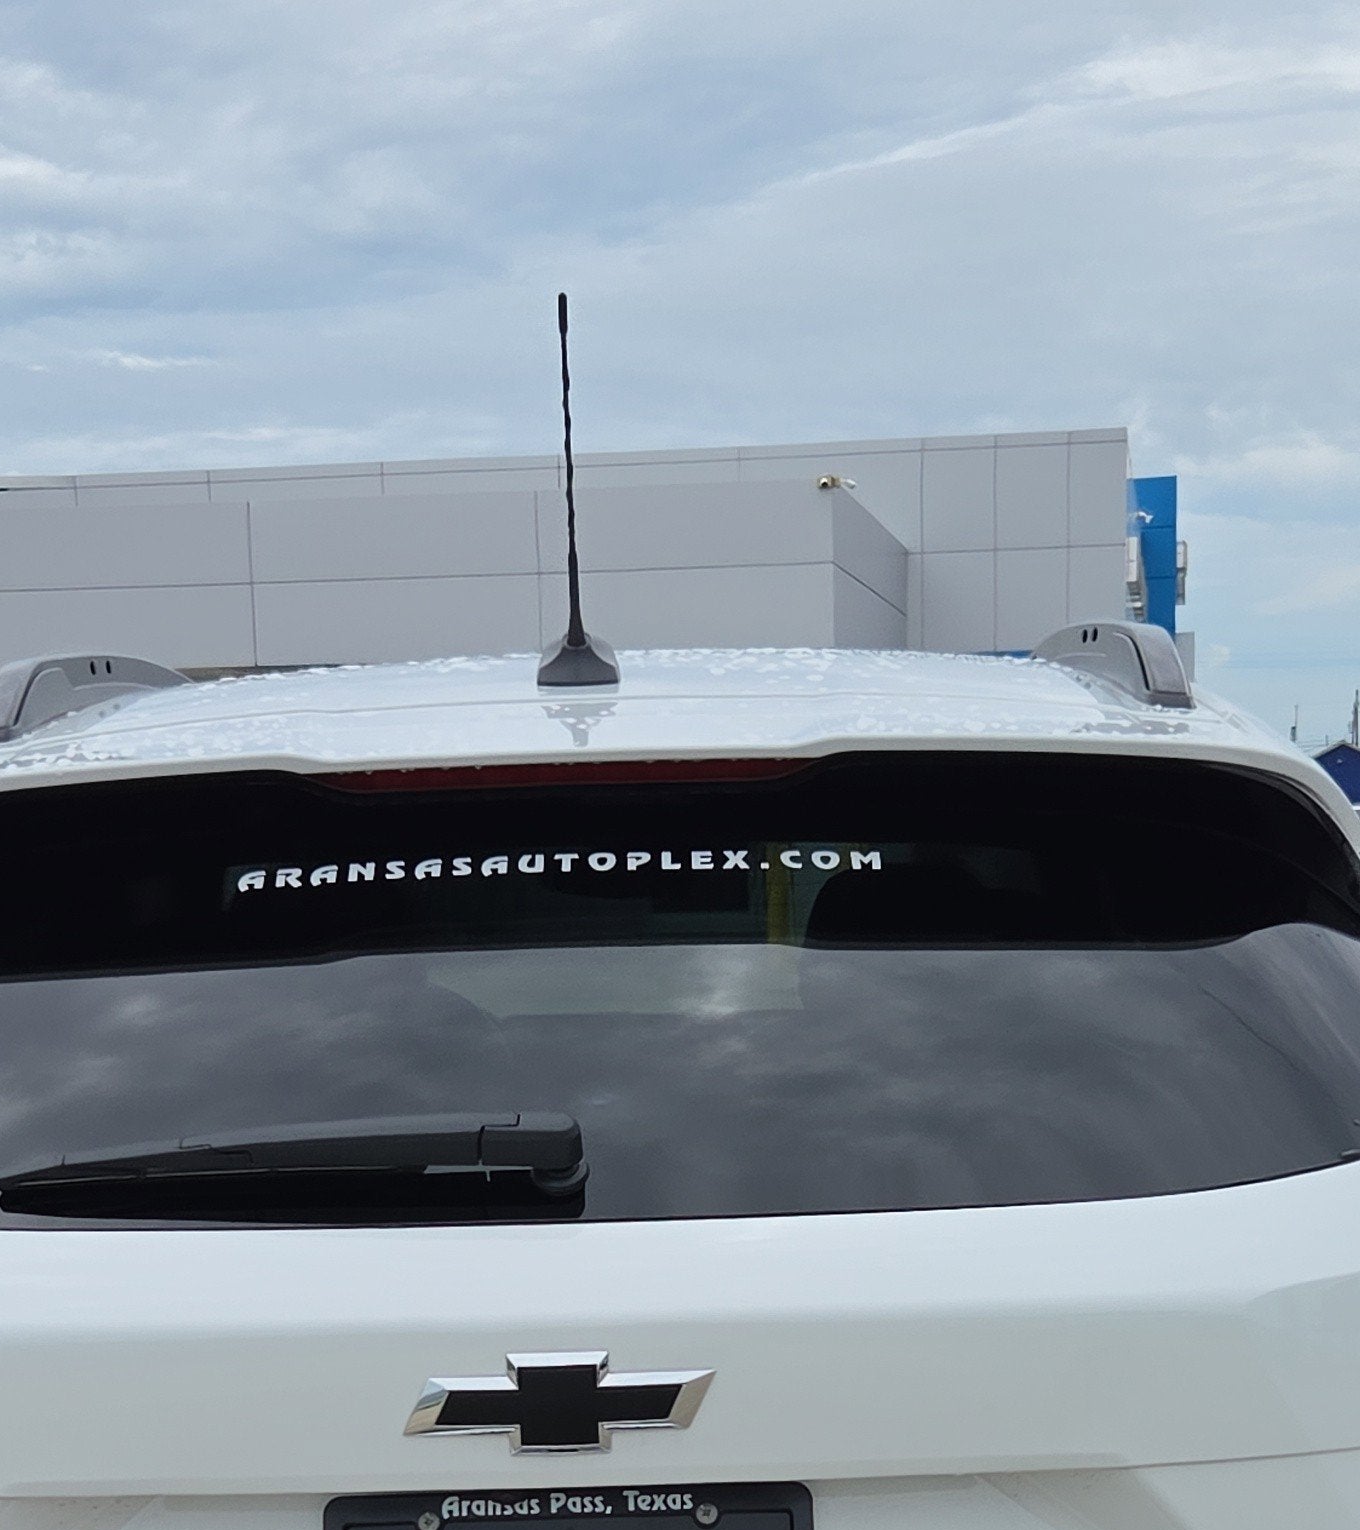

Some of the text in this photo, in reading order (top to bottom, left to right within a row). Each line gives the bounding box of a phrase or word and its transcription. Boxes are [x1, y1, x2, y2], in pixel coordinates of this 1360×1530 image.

[237, 849, 882, 892] ARANSASAUTOPLEX.COM
[549, 1491, 613, 1515] Pass,
[622, 1489, 694, 1512] Texas
